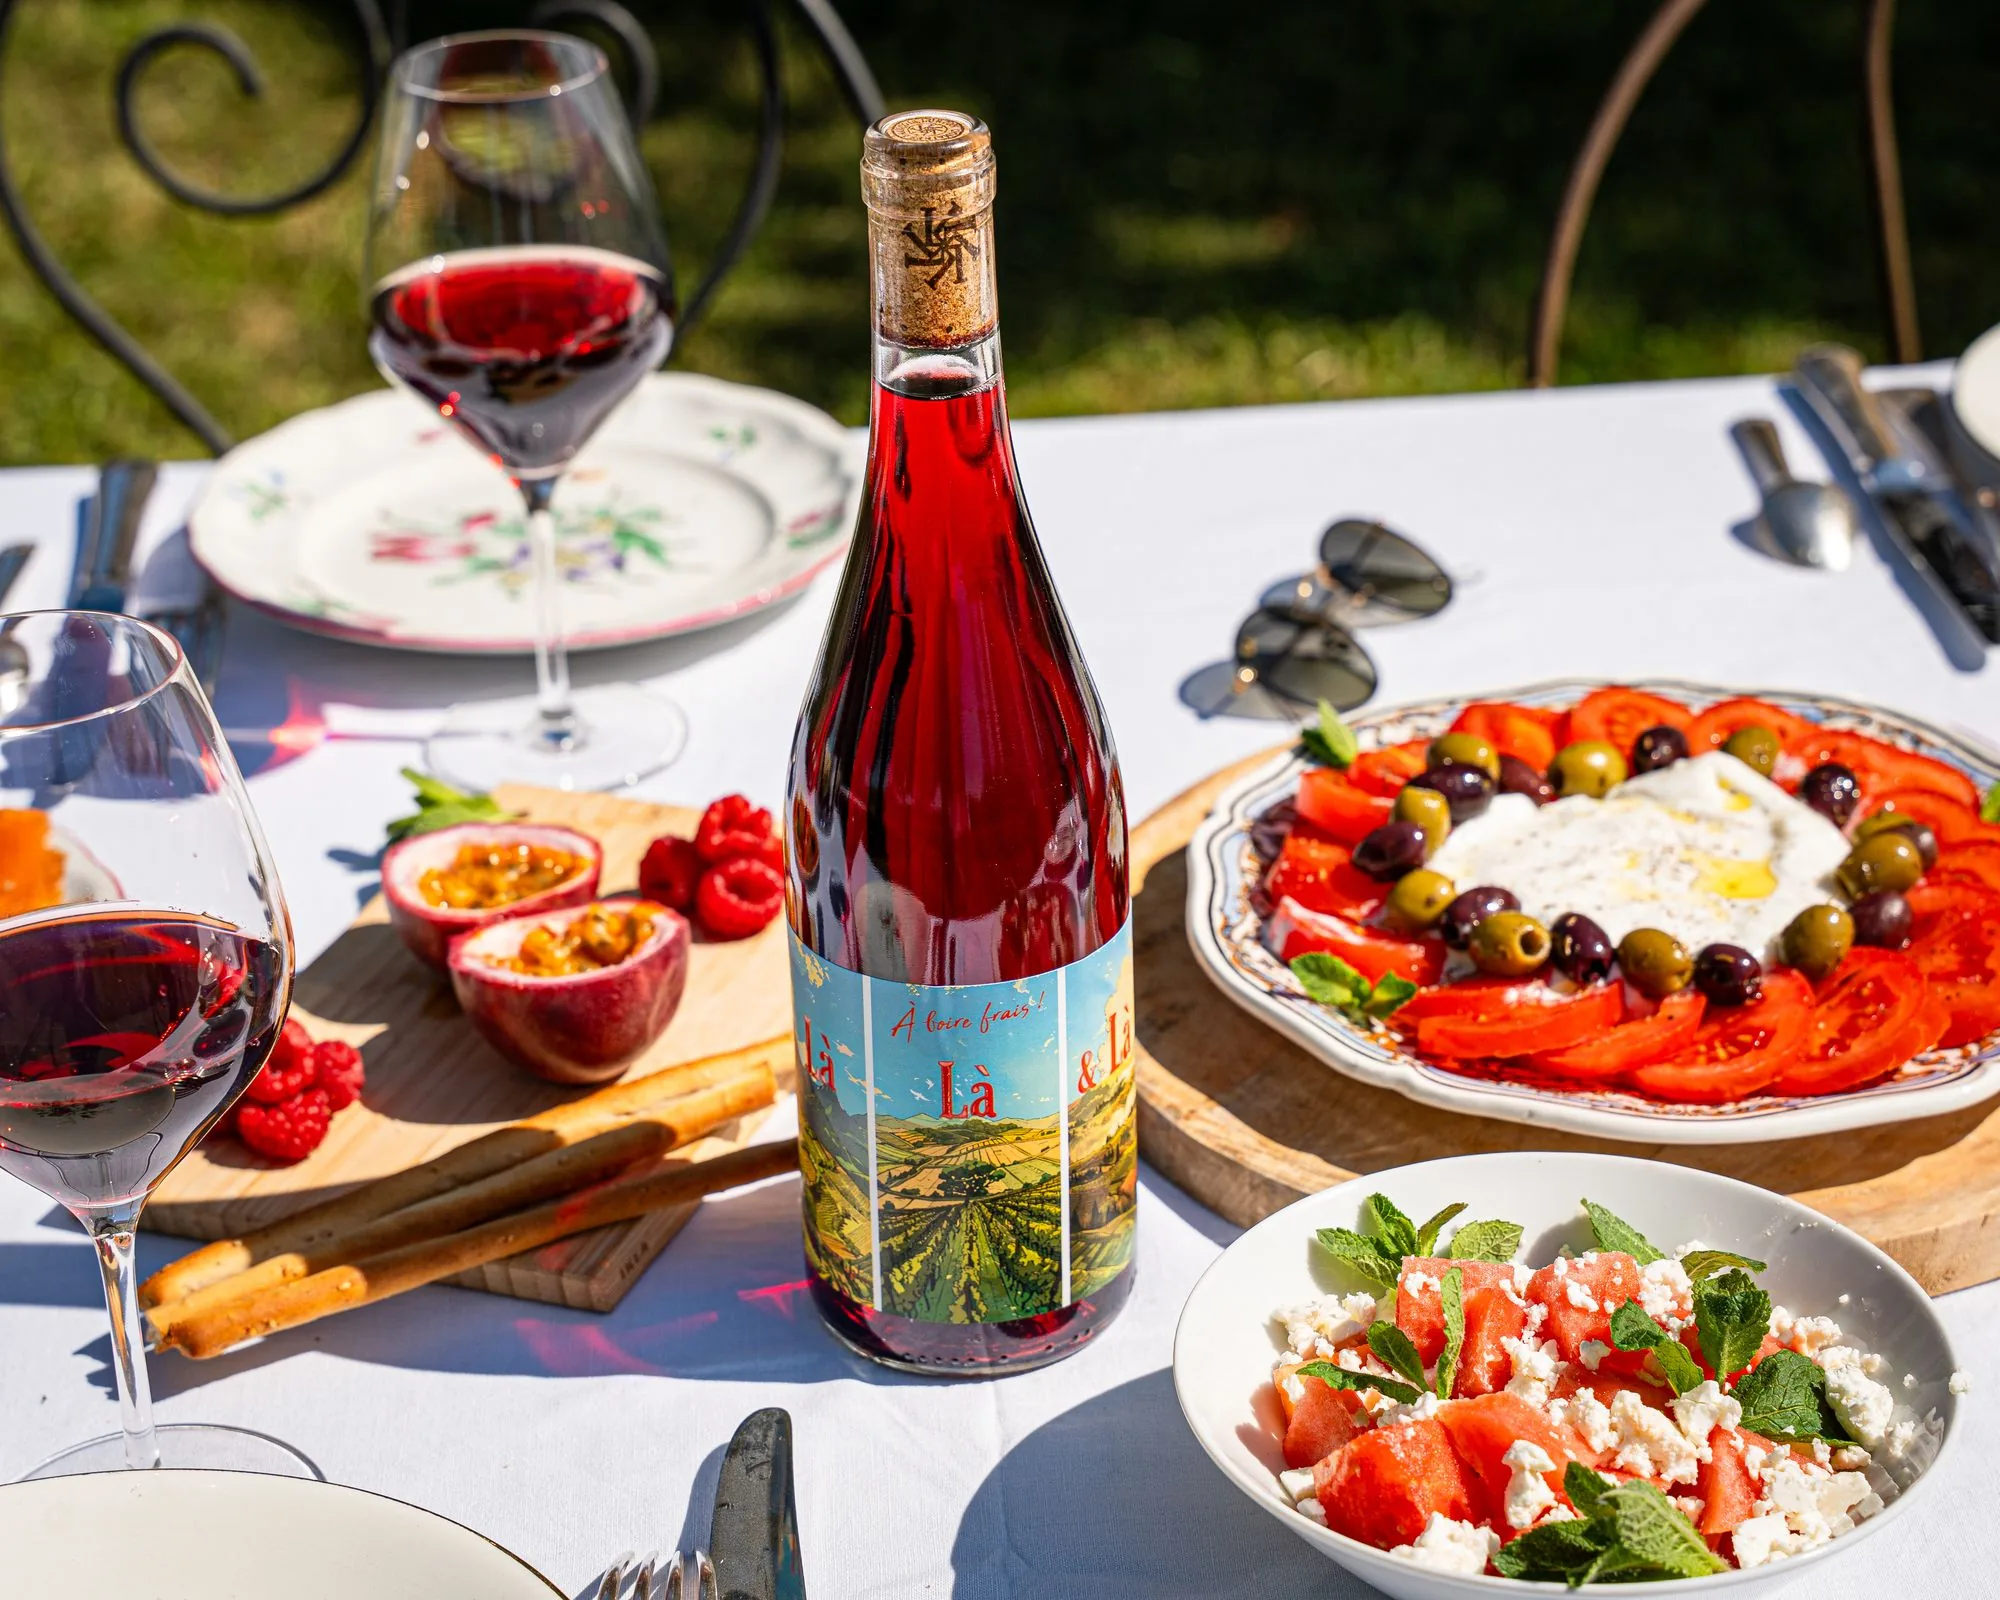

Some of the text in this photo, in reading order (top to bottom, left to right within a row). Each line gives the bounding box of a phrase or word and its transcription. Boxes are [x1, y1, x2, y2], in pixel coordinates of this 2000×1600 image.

[803, 1003, 1131, 1119] Là Là & Là
[891, 1001, 915, 1043] À
[922, 1010, 973, 1033] boire
